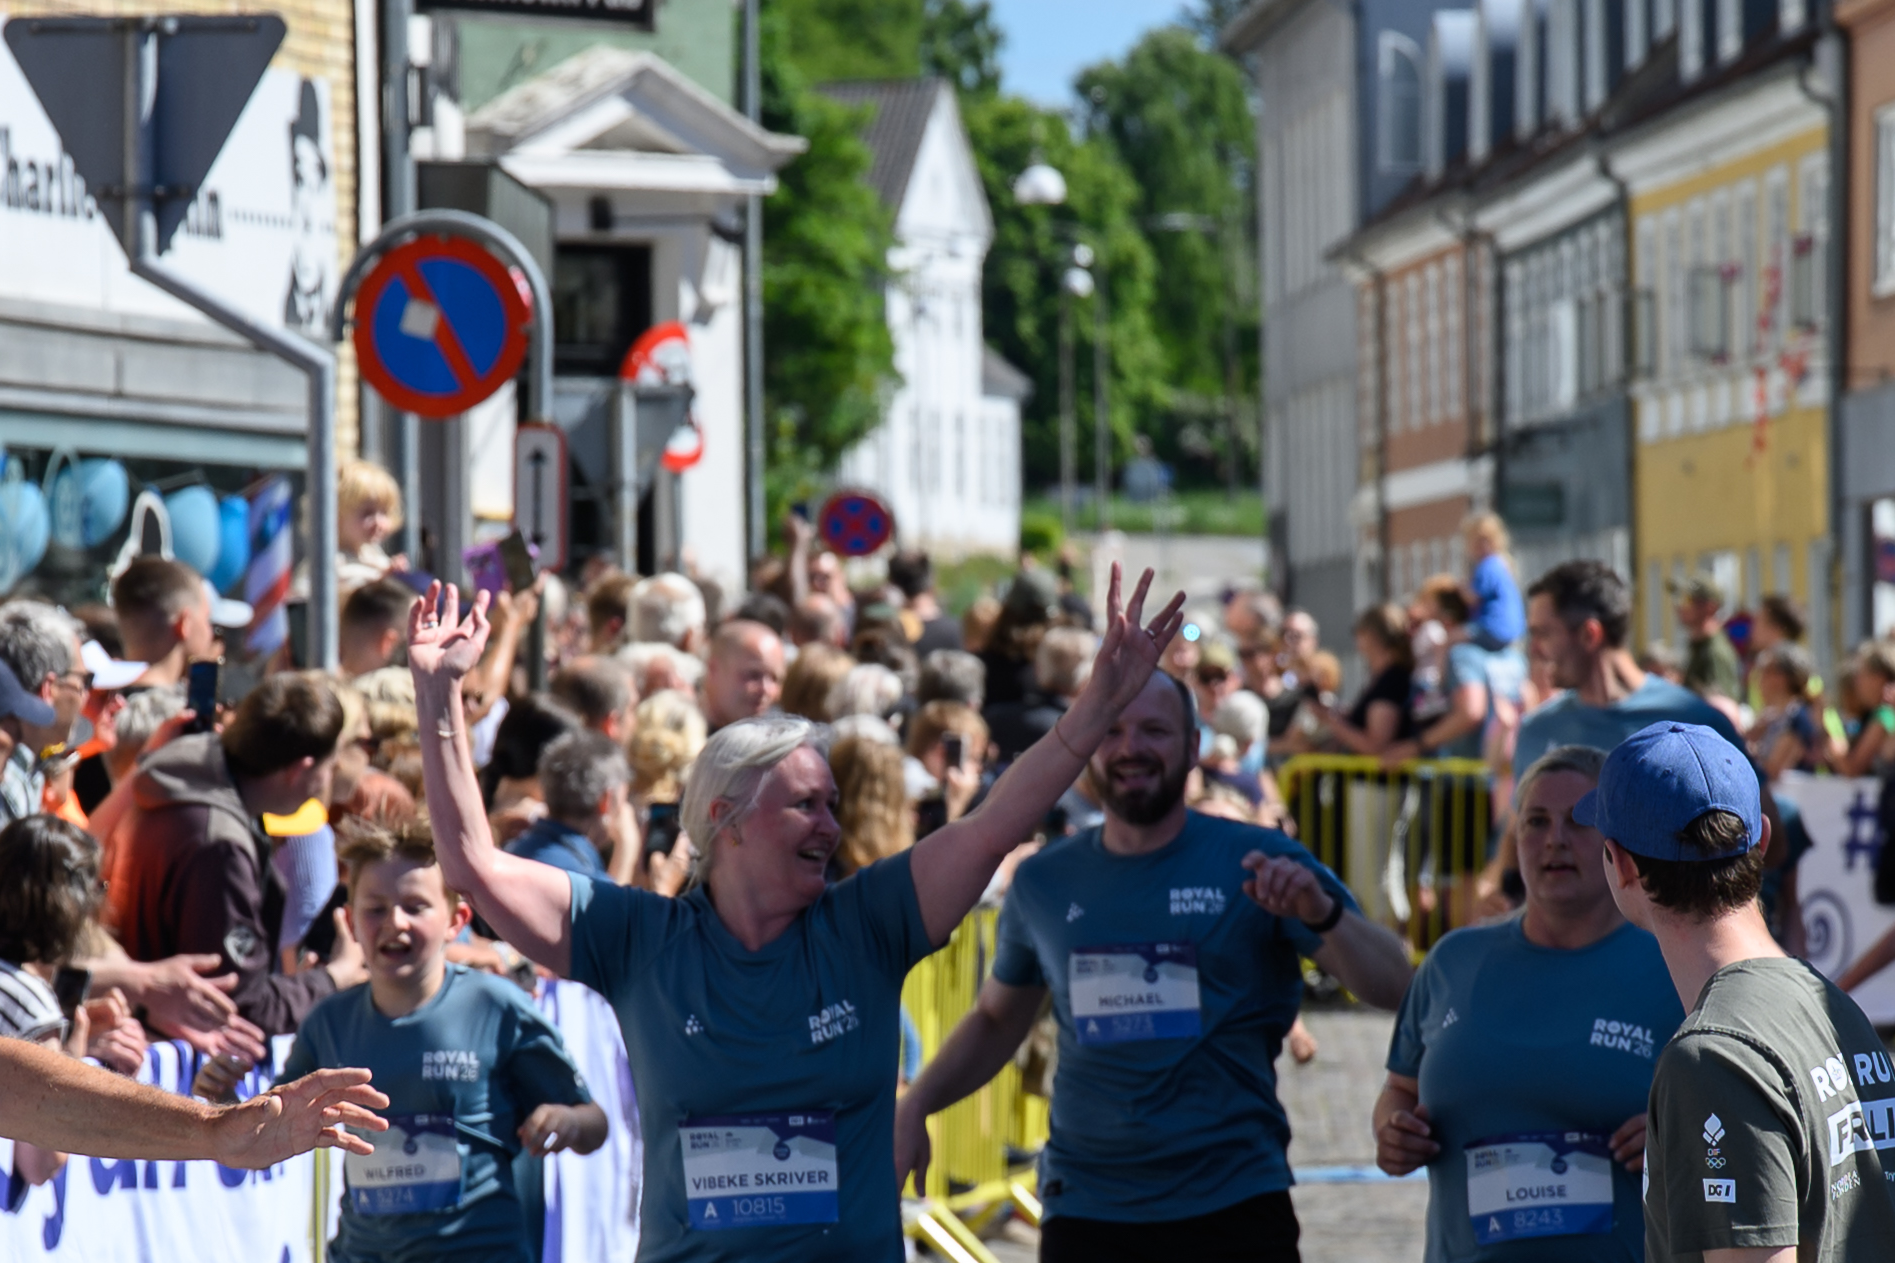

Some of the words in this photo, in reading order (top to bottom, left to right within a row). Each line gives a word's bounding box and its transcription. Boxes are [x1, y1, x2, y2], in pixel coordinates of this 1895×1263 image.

[1169, 887, 1225, 901] ROYAL
[1098, 993, 1163, 1008] MICHAEL
[808, 1000, 855, 1030] ROYAL
[1086, 1019, 1099, 1033] A
[1593, 1018, 1654, 1045] ROYAL
[423, 1051, 479, 1065] ROYAL
[364, 1163, 426, 1180] WILFRED
[692, 1174, 749, 1190] VIBEKE
[754, 1170, 829, 1187] SKRIVER
[1507, 1185, 1566, 1201] LOUISE
[1707, 1184, 1732, 1197] DGI
[704, 1202, 718, 1219] A
[732, 1197, 786, 1216] 10815
[1489, 1217, 1500, 1233] A
[1514, 1208, 1565, 1228] 8243
